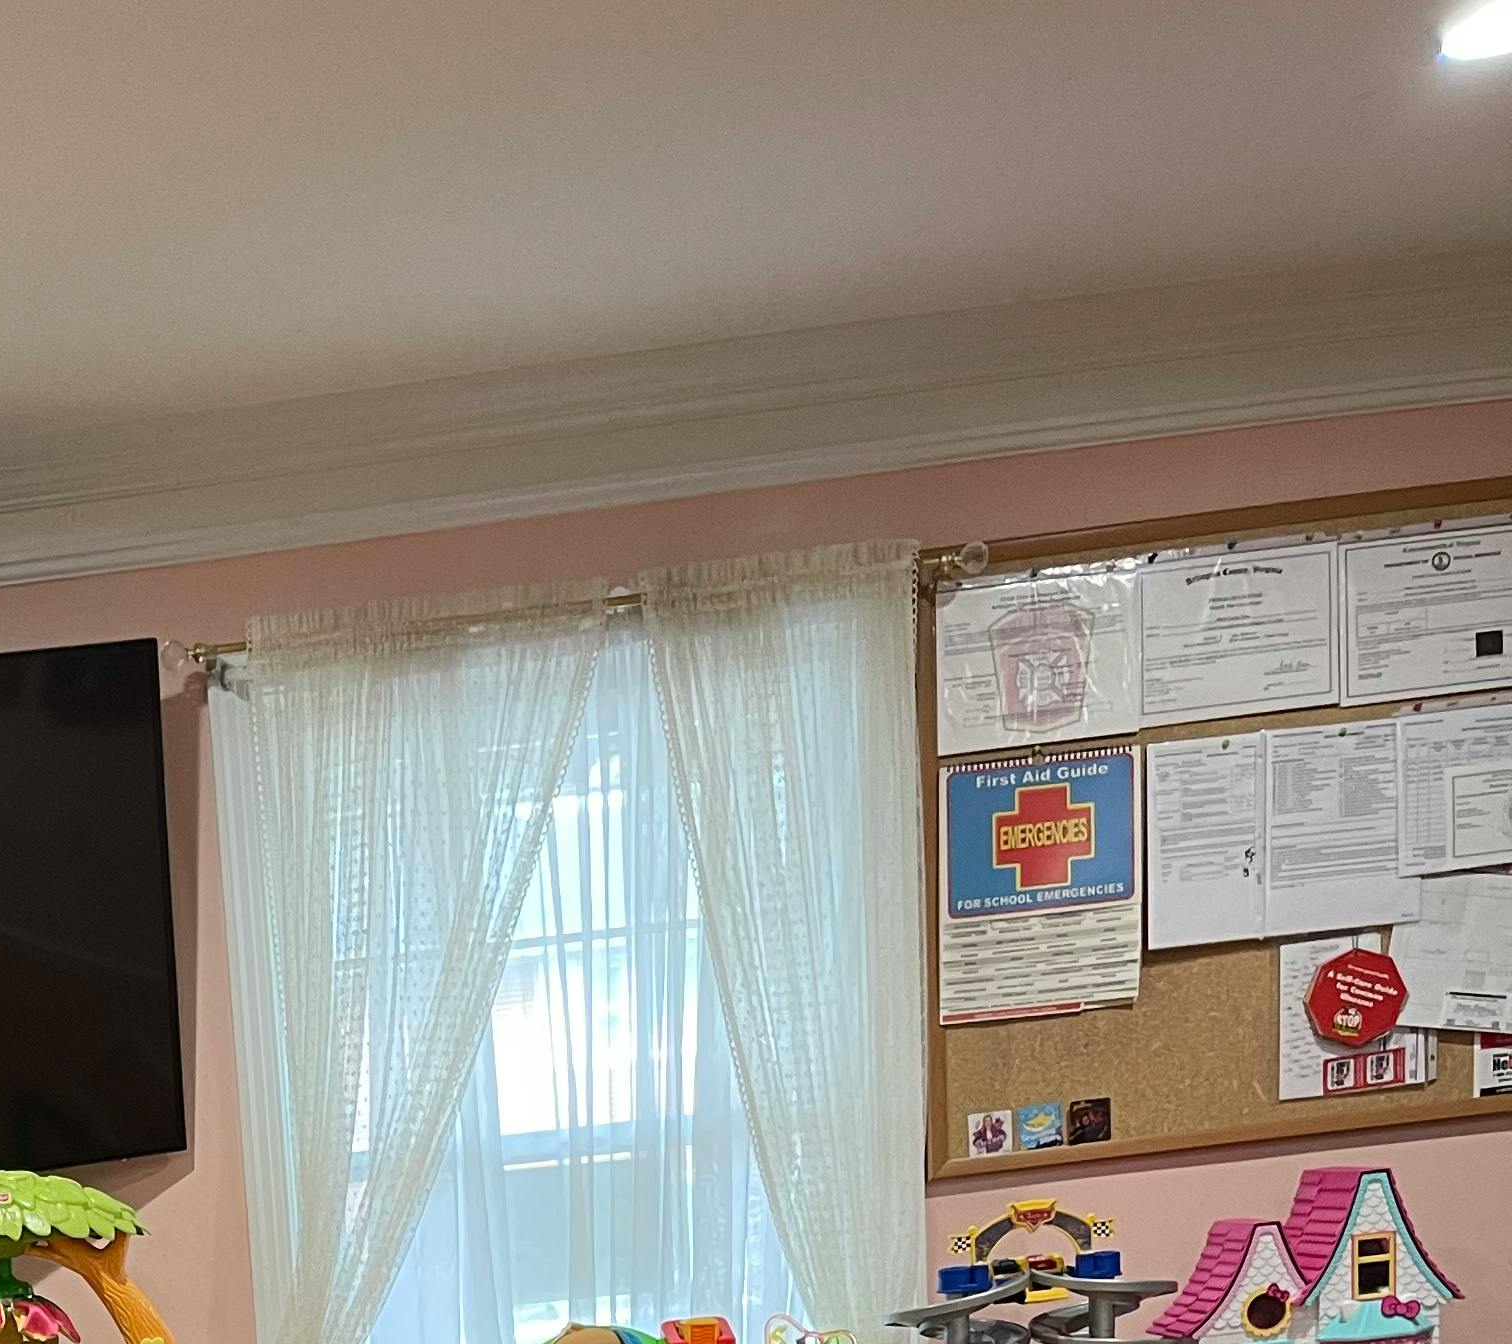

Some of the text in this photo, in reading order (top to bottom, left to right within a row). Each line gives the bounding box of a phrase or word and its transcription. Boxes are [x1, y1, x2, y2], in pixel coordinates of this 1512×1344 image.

[976, 763, 1109, 788] First Aid Guide
[999, 818, 1088, 851] EMERGENCIES
[957, 882, 1124, 911] FOR SCHOOL EMERGENCIES
